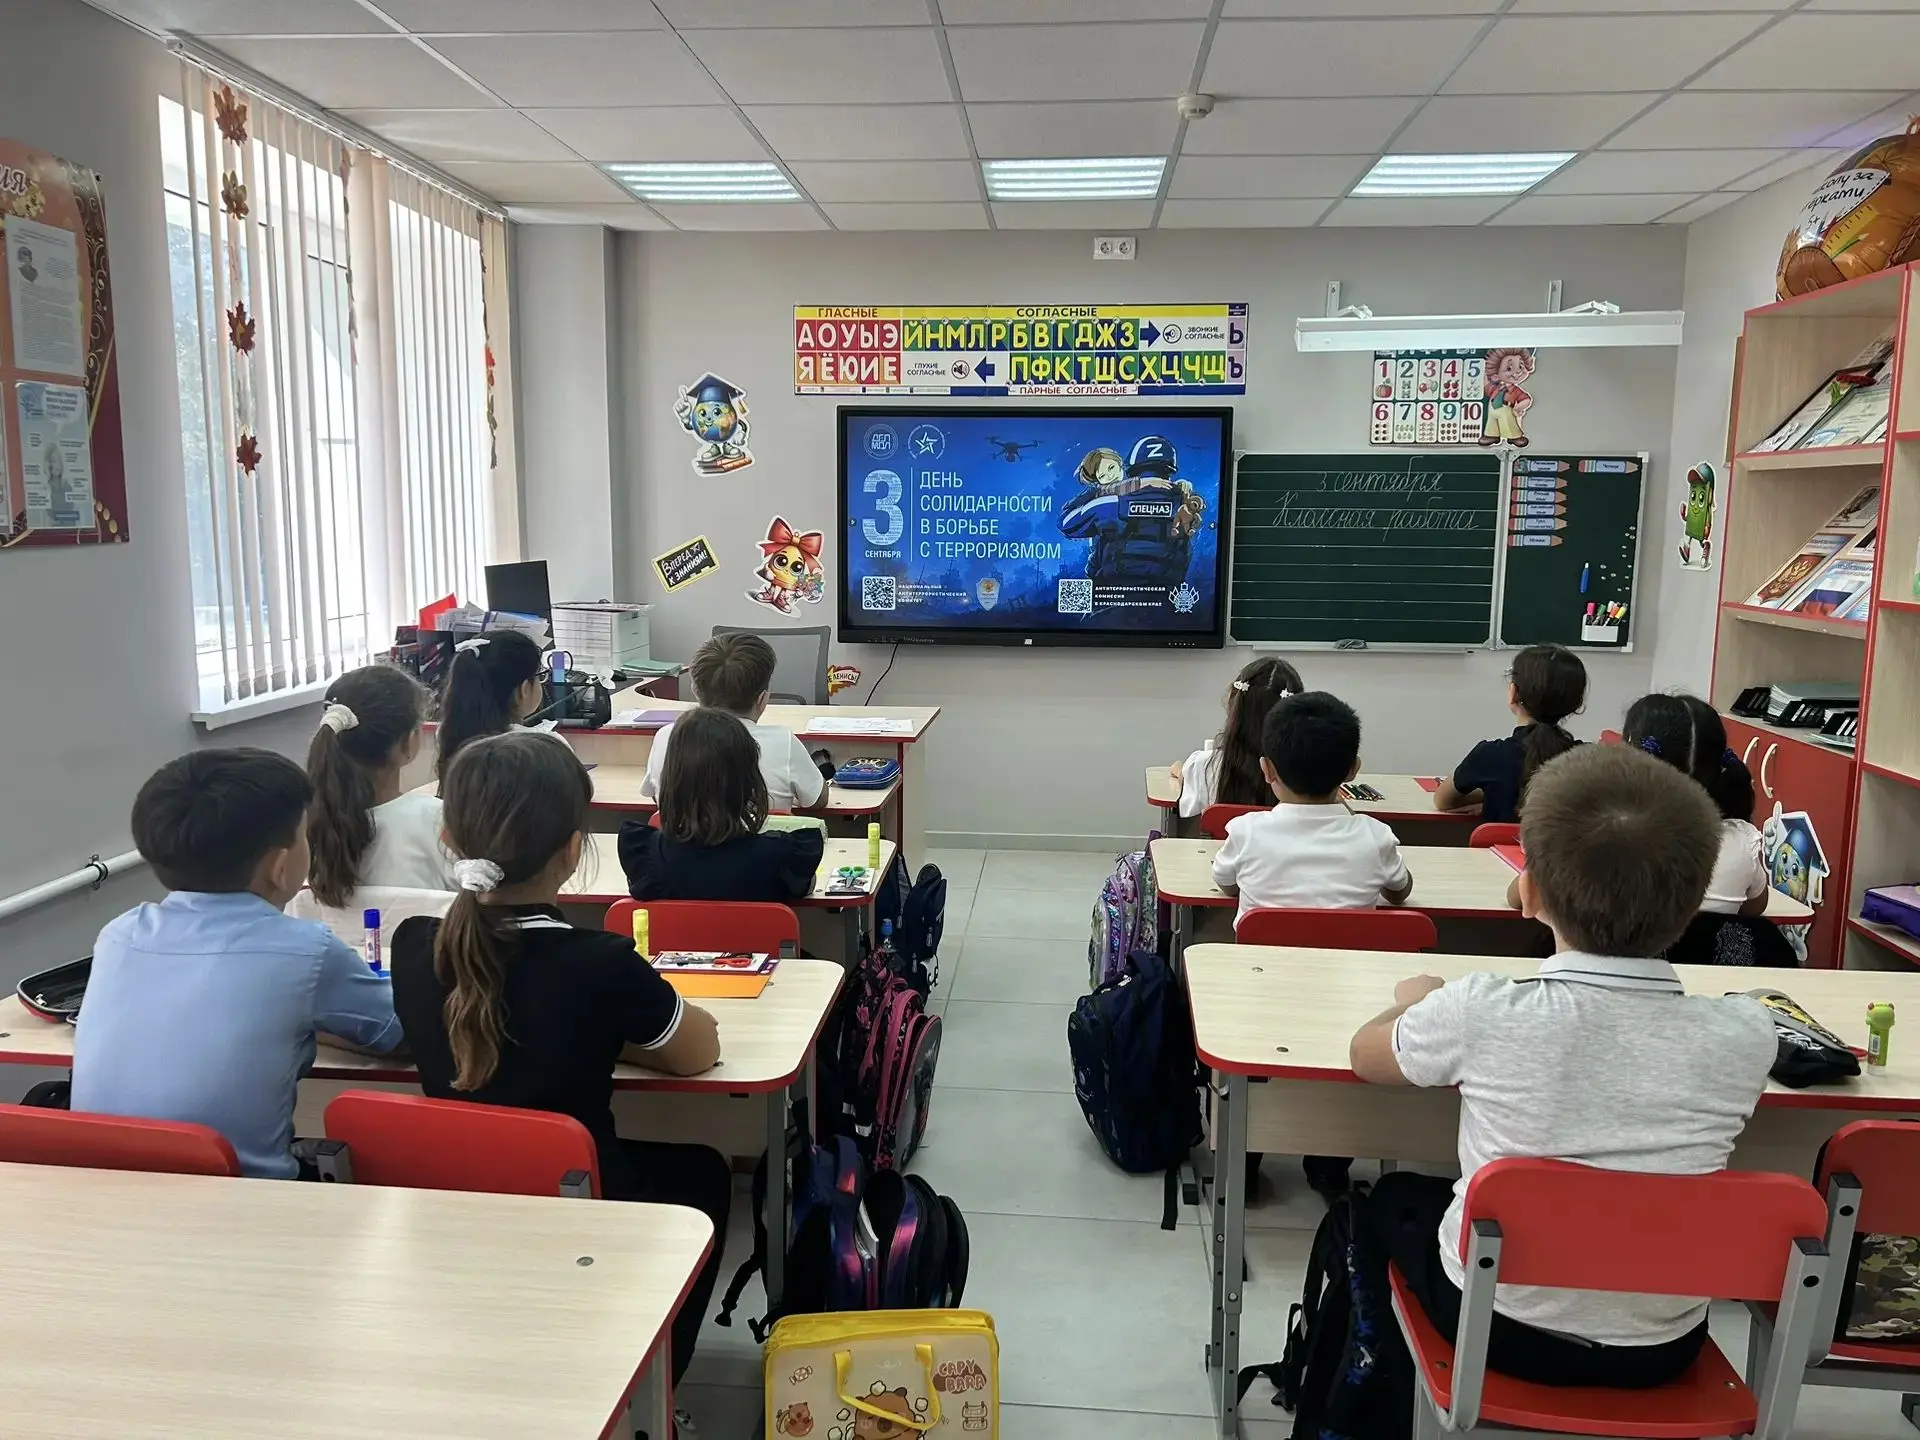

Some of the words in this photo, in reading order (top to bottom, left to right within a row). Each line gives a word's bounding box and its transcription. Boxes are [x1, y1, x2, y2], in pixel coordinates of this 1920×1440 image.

[818, 308, 878, 318] ГЛАСНЫЕ
[1016, 307, 1097, 318] СОГЛАСНЫЕ
[1379, 361, 1388, 378] 1
[1400, 360, 1414, 379] 2
[1423, 360, 1436, 378] 3
[1444, 360, 1457, 377] 4
[1467, 359, 1481, 378] 5
[1019, 385, 1061, 395] ПАРНЫЕ
[1066, 384, 1128, 395] СОГЛАСНЫЕ
[1375, 403, 1389, 421] 6
[1399, 403, 1412, 421] 7
[1420, 403, 1434, 421] 8
[1442, 403, 1456, 420] 9
[1462, 402, 1482, 421] 10
[1146, 443, 1163, 458] Z
[920, 471, 963, 489] ДЕНЬ
[1316, 472, 1328, 492] 3
[862, 469, 904, 546] 3
[920, 495, 1052, 513] СОЛИДАРНОСТИ
[1130, 504, 1170, 515] СПЕЦНАЗ
[1273, 491, 1376, 528] Классная
[1382, 497, 1479, 543] работа
[920, 518, 930, 534] В
[936, 518, 999, 535] БОРЬБЕ
[865, 550, 901, 558] СЕНТЯБРЯ
[920, 542, 930, 558] С
[935, 542, 1061, 559] ТЕРРОРИЗМОМ
[938, 1359, 975, 1377] CAPY
[945, 1375, 986, 1392] BARA
